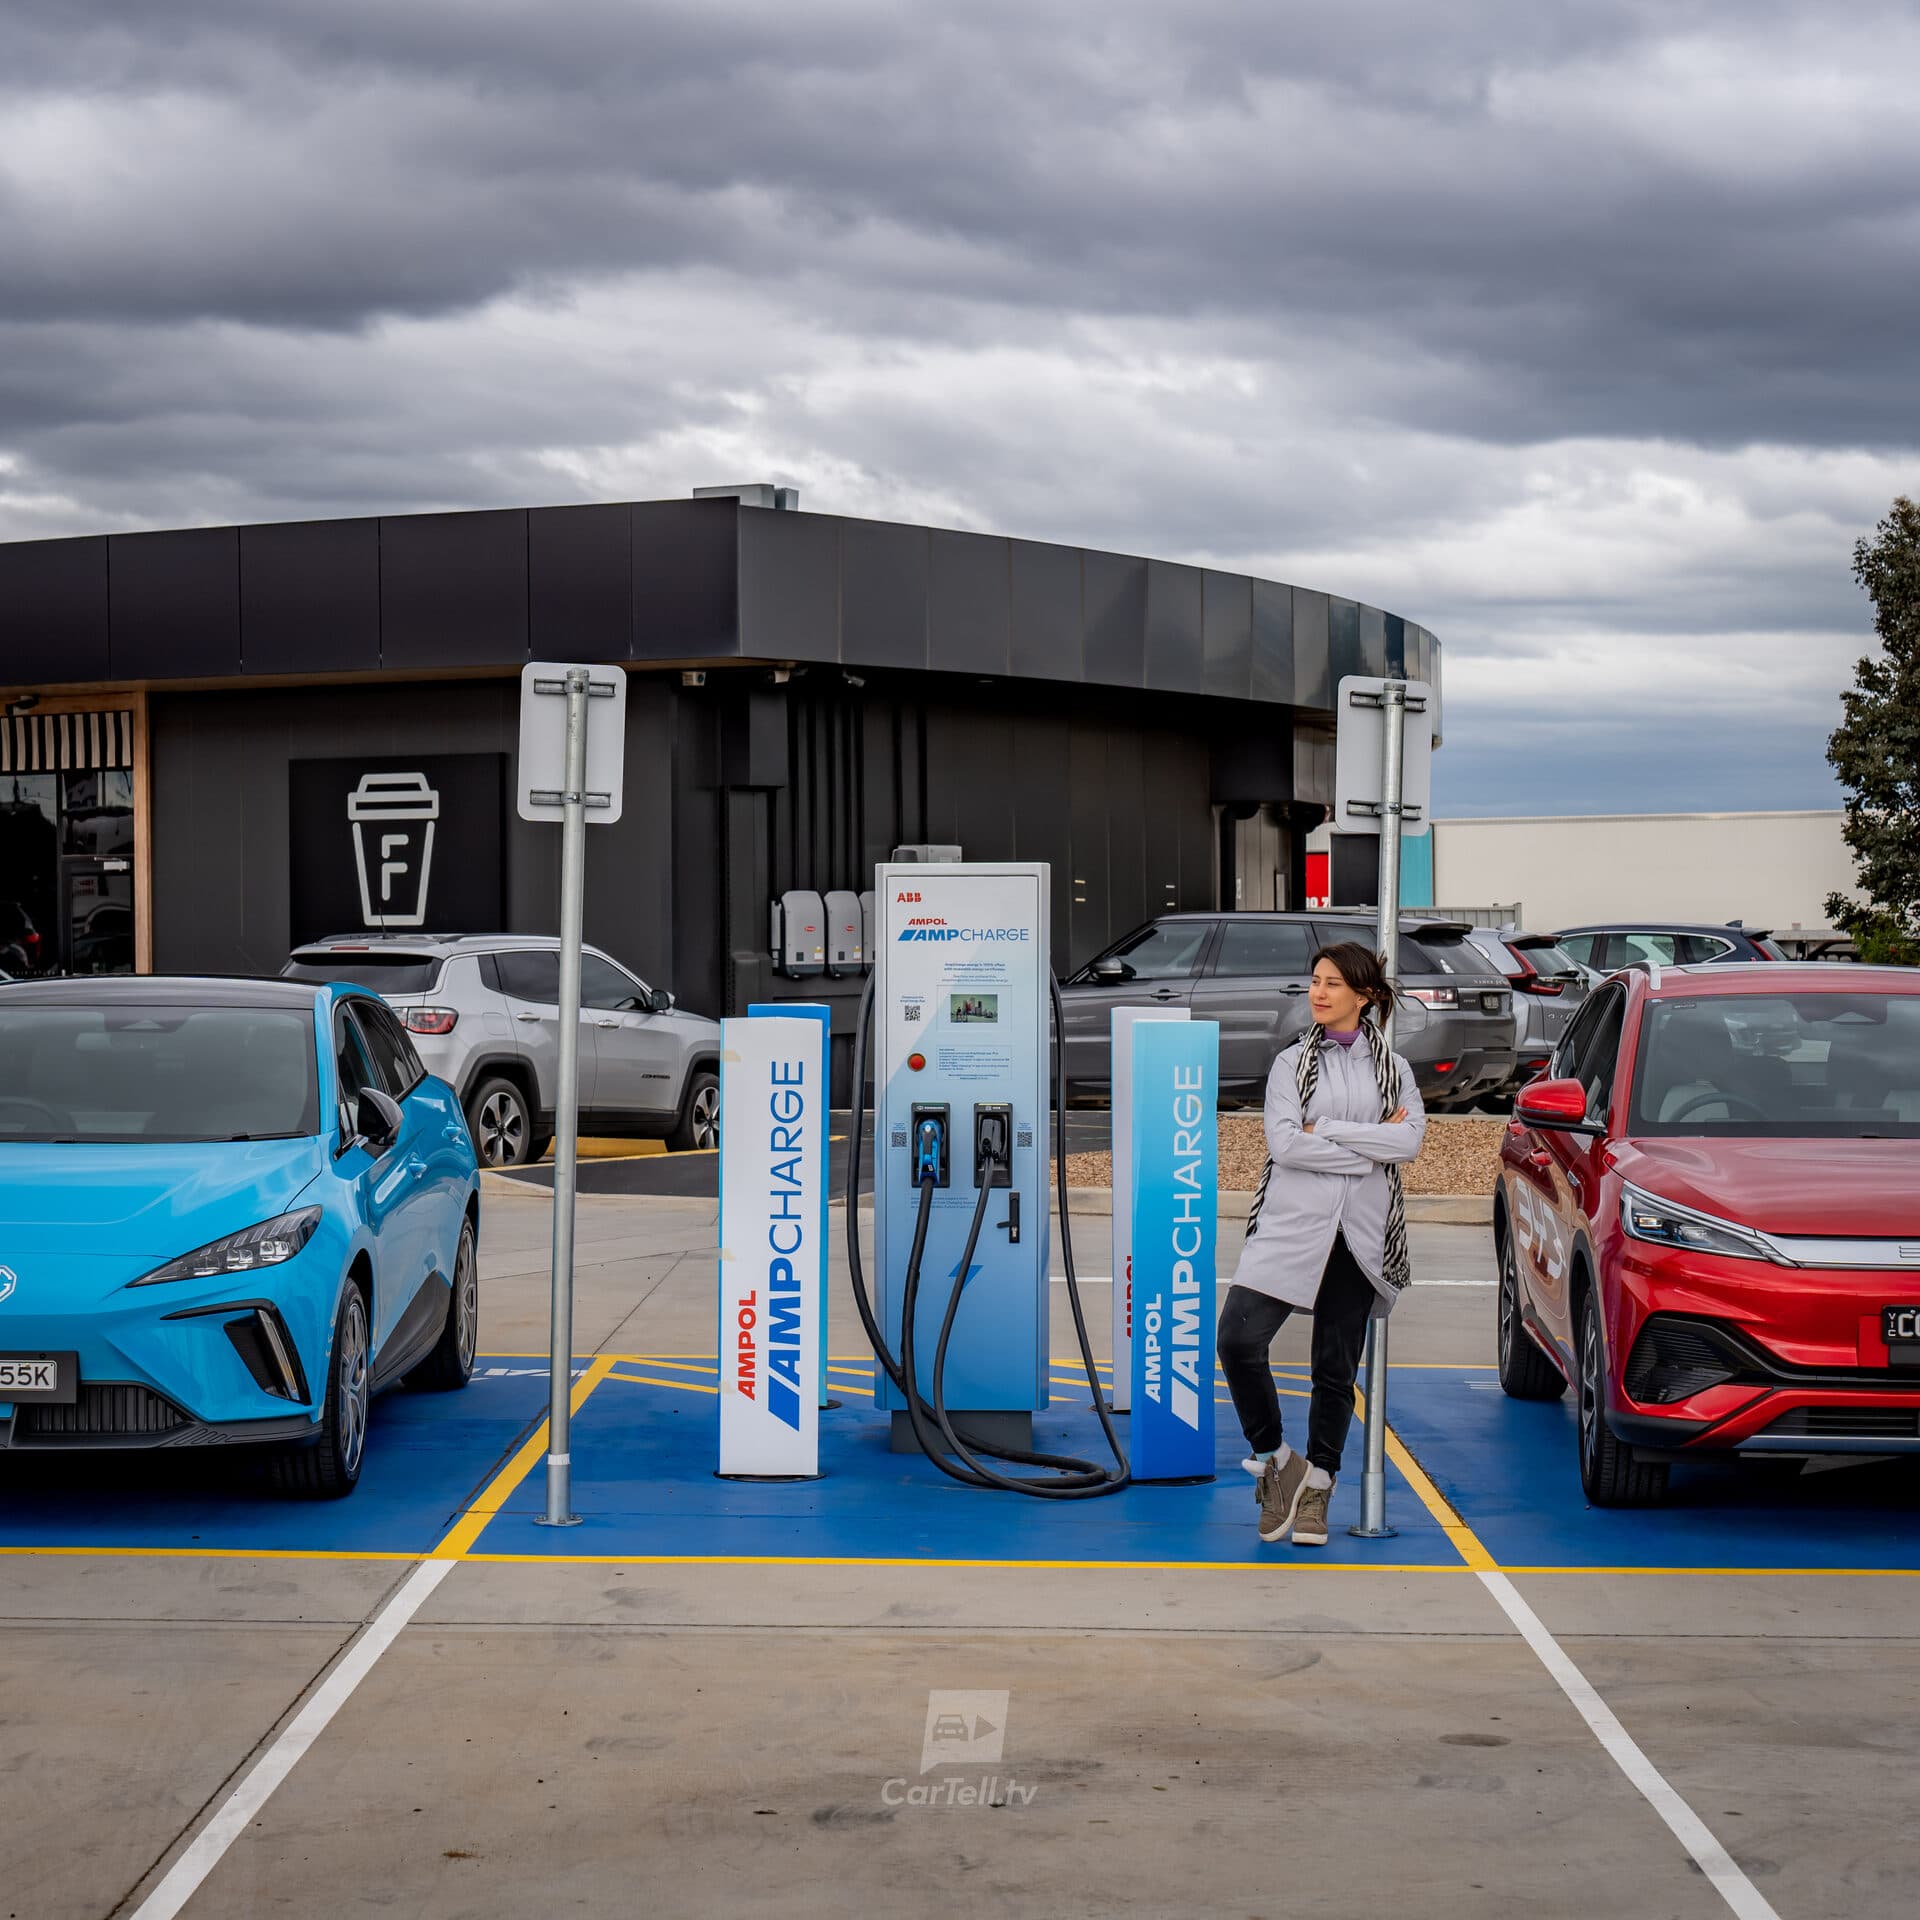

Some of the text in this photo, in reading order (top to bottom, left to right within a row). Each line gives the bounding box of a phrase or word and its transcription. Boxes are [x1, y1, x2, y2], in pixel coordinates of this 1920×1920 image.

[897, 892, 922, 902] ABB
[908, 918, 947, 926] AMPOL
[913, 928, 1029, 942] AMPCHARGE
[768, 1060, 805, 1387] AMPCHARGE
[1171, 1064, 1204, 1387] AMPCHARGE
[1887, 1312, 1897, 1337] VIC
[737, 1289, 757, 1400] AMPOL
[1143, 1293, 1162, 1403] AMPOL
[0, 1366, 50, 1386] 55K
